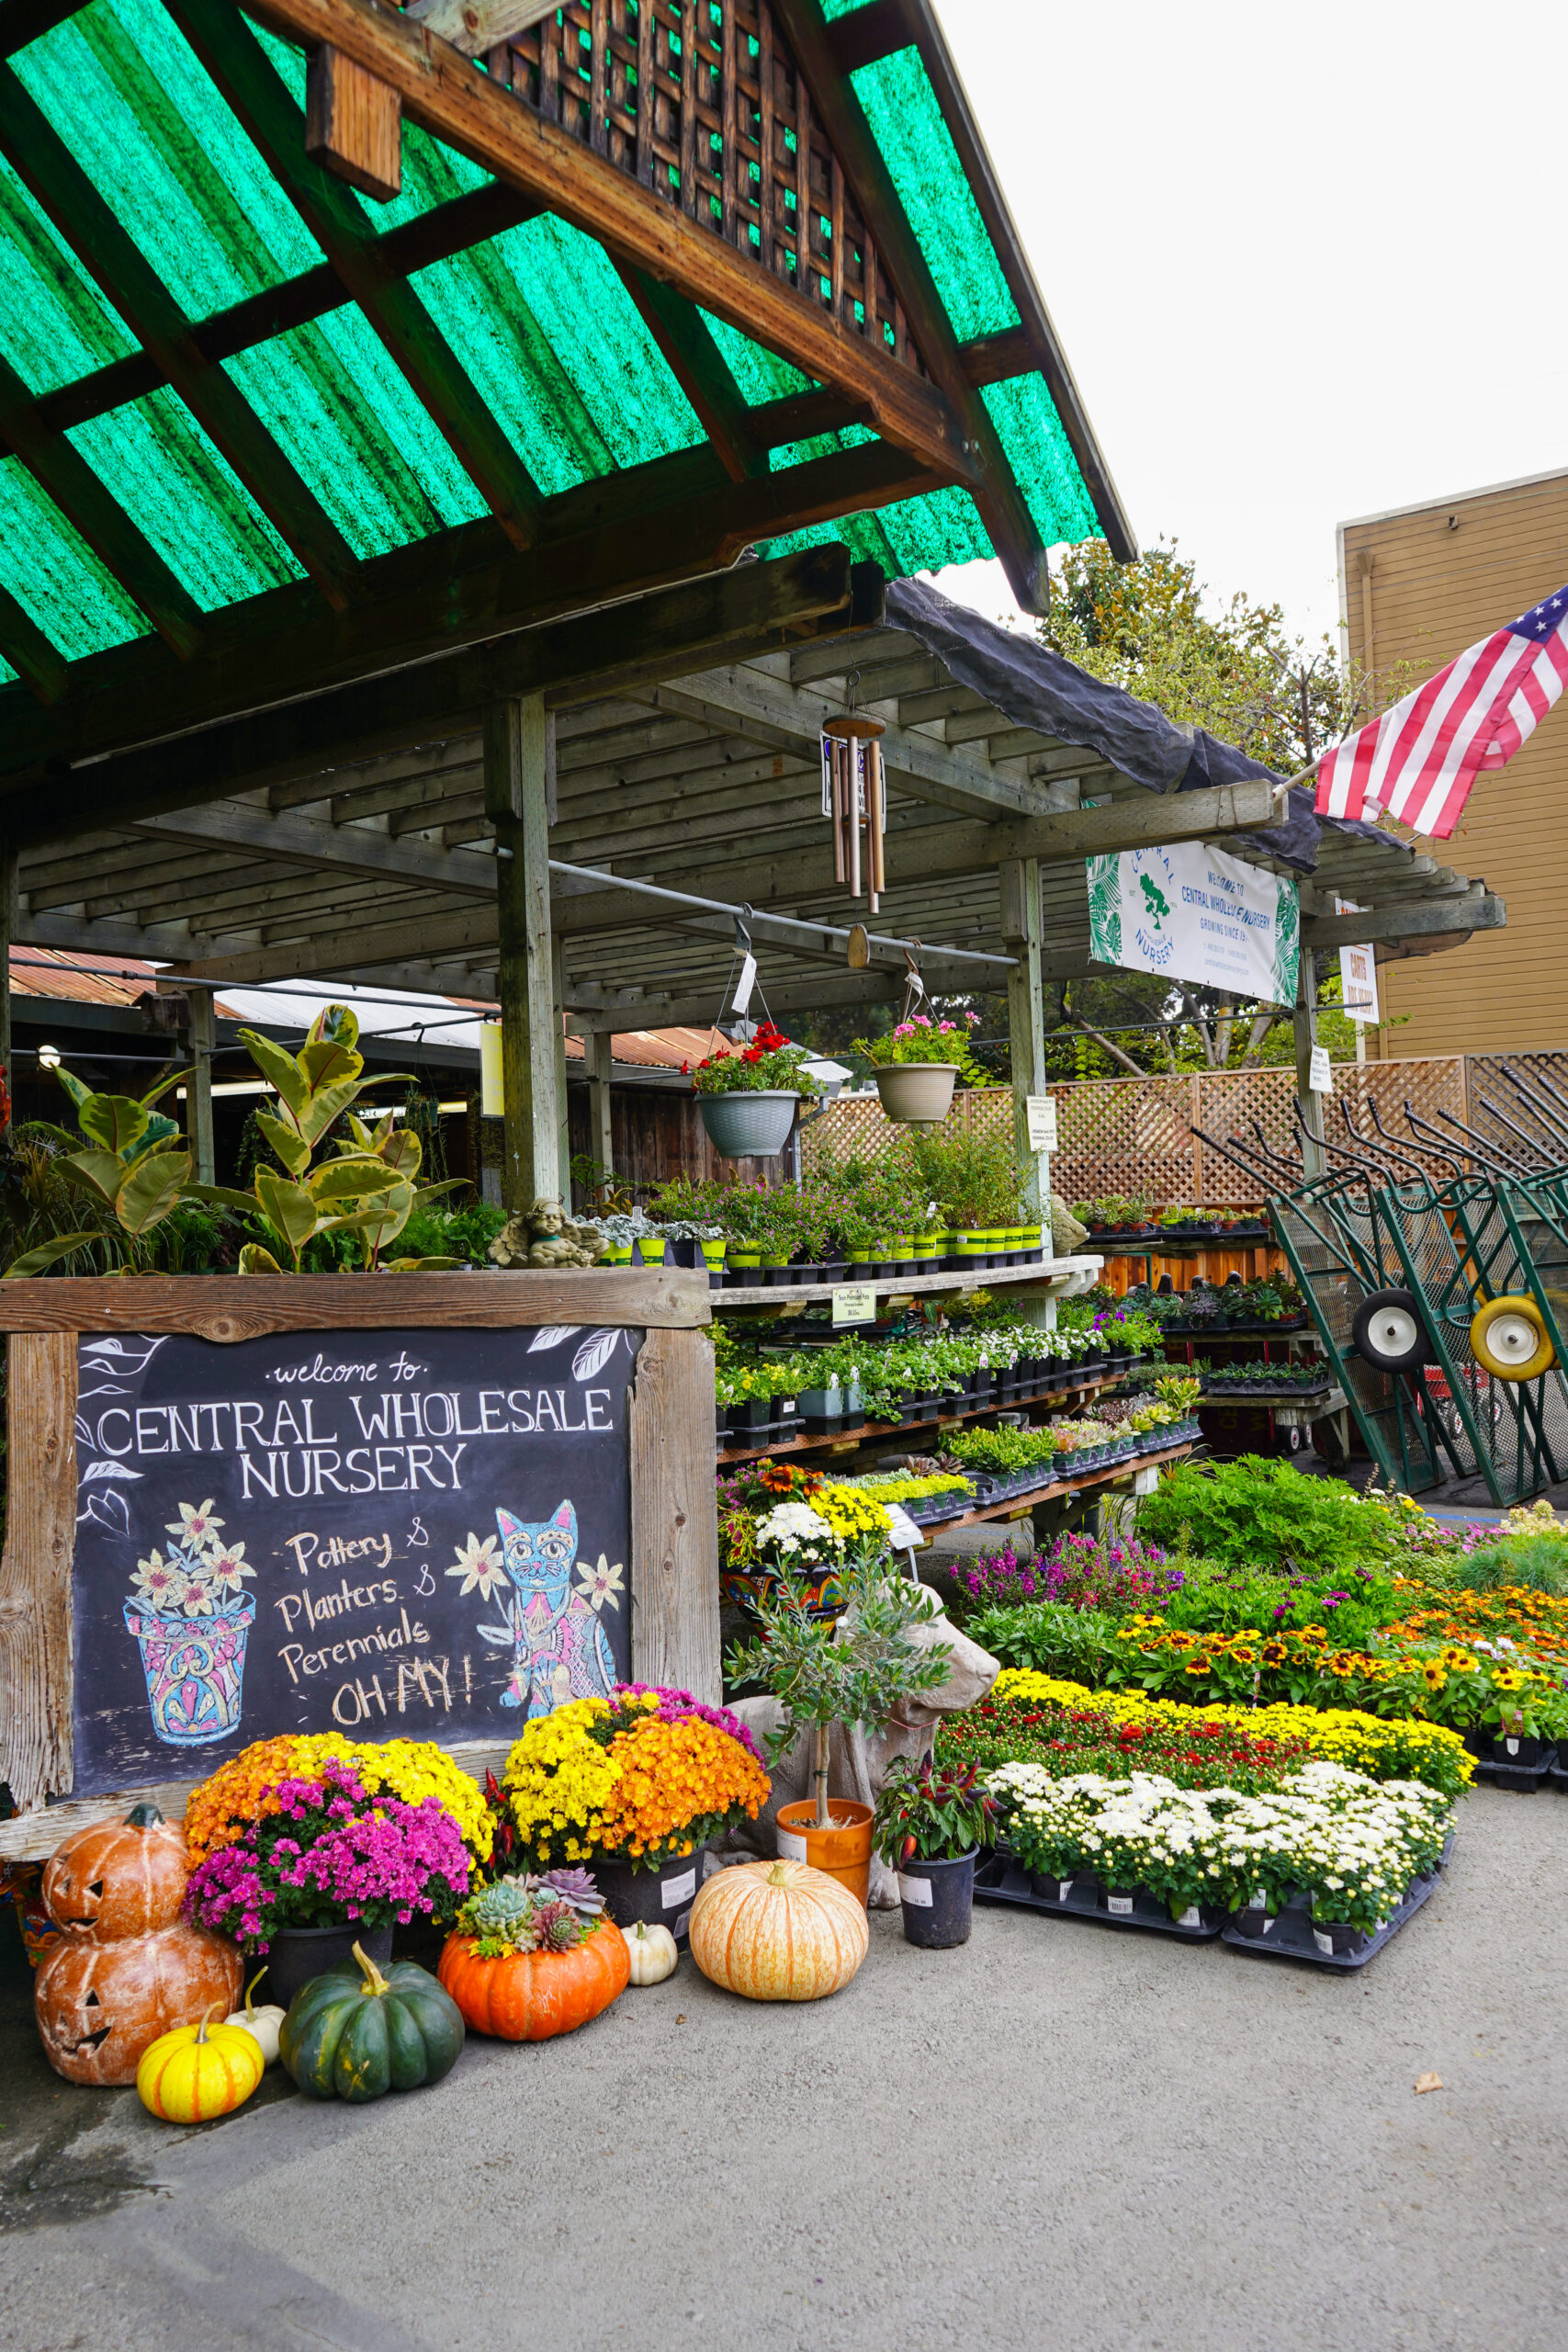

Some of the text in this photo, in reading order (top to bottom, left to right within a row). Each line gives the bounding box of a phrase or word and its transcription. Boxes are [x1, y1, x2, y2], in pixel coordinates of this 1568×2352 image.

[1181, 886, 1209, 910] CENTRAL
[1241, 909, 1270, 931] NURSERY
[1236, 883, 1245, 897] TO
[1134, 928, 1174, 965] NURSERY
[1200, 918, 1224, 935] GROWING
[1224, 925, 1238, 940] SINCE
[274, 1351, 422, 1384] welcome to
[96, 1389, 614, 1456] CENTRAL WHOLESALE
[240, 1442, 467, 1499] NURSERY
[285, 1532, 392, 1577] Pottery
[273, 1578, 398, 1633] Planters
[277, 1607, 432, 1685] Perennials
[332, 1674, 388, 1725] OH
